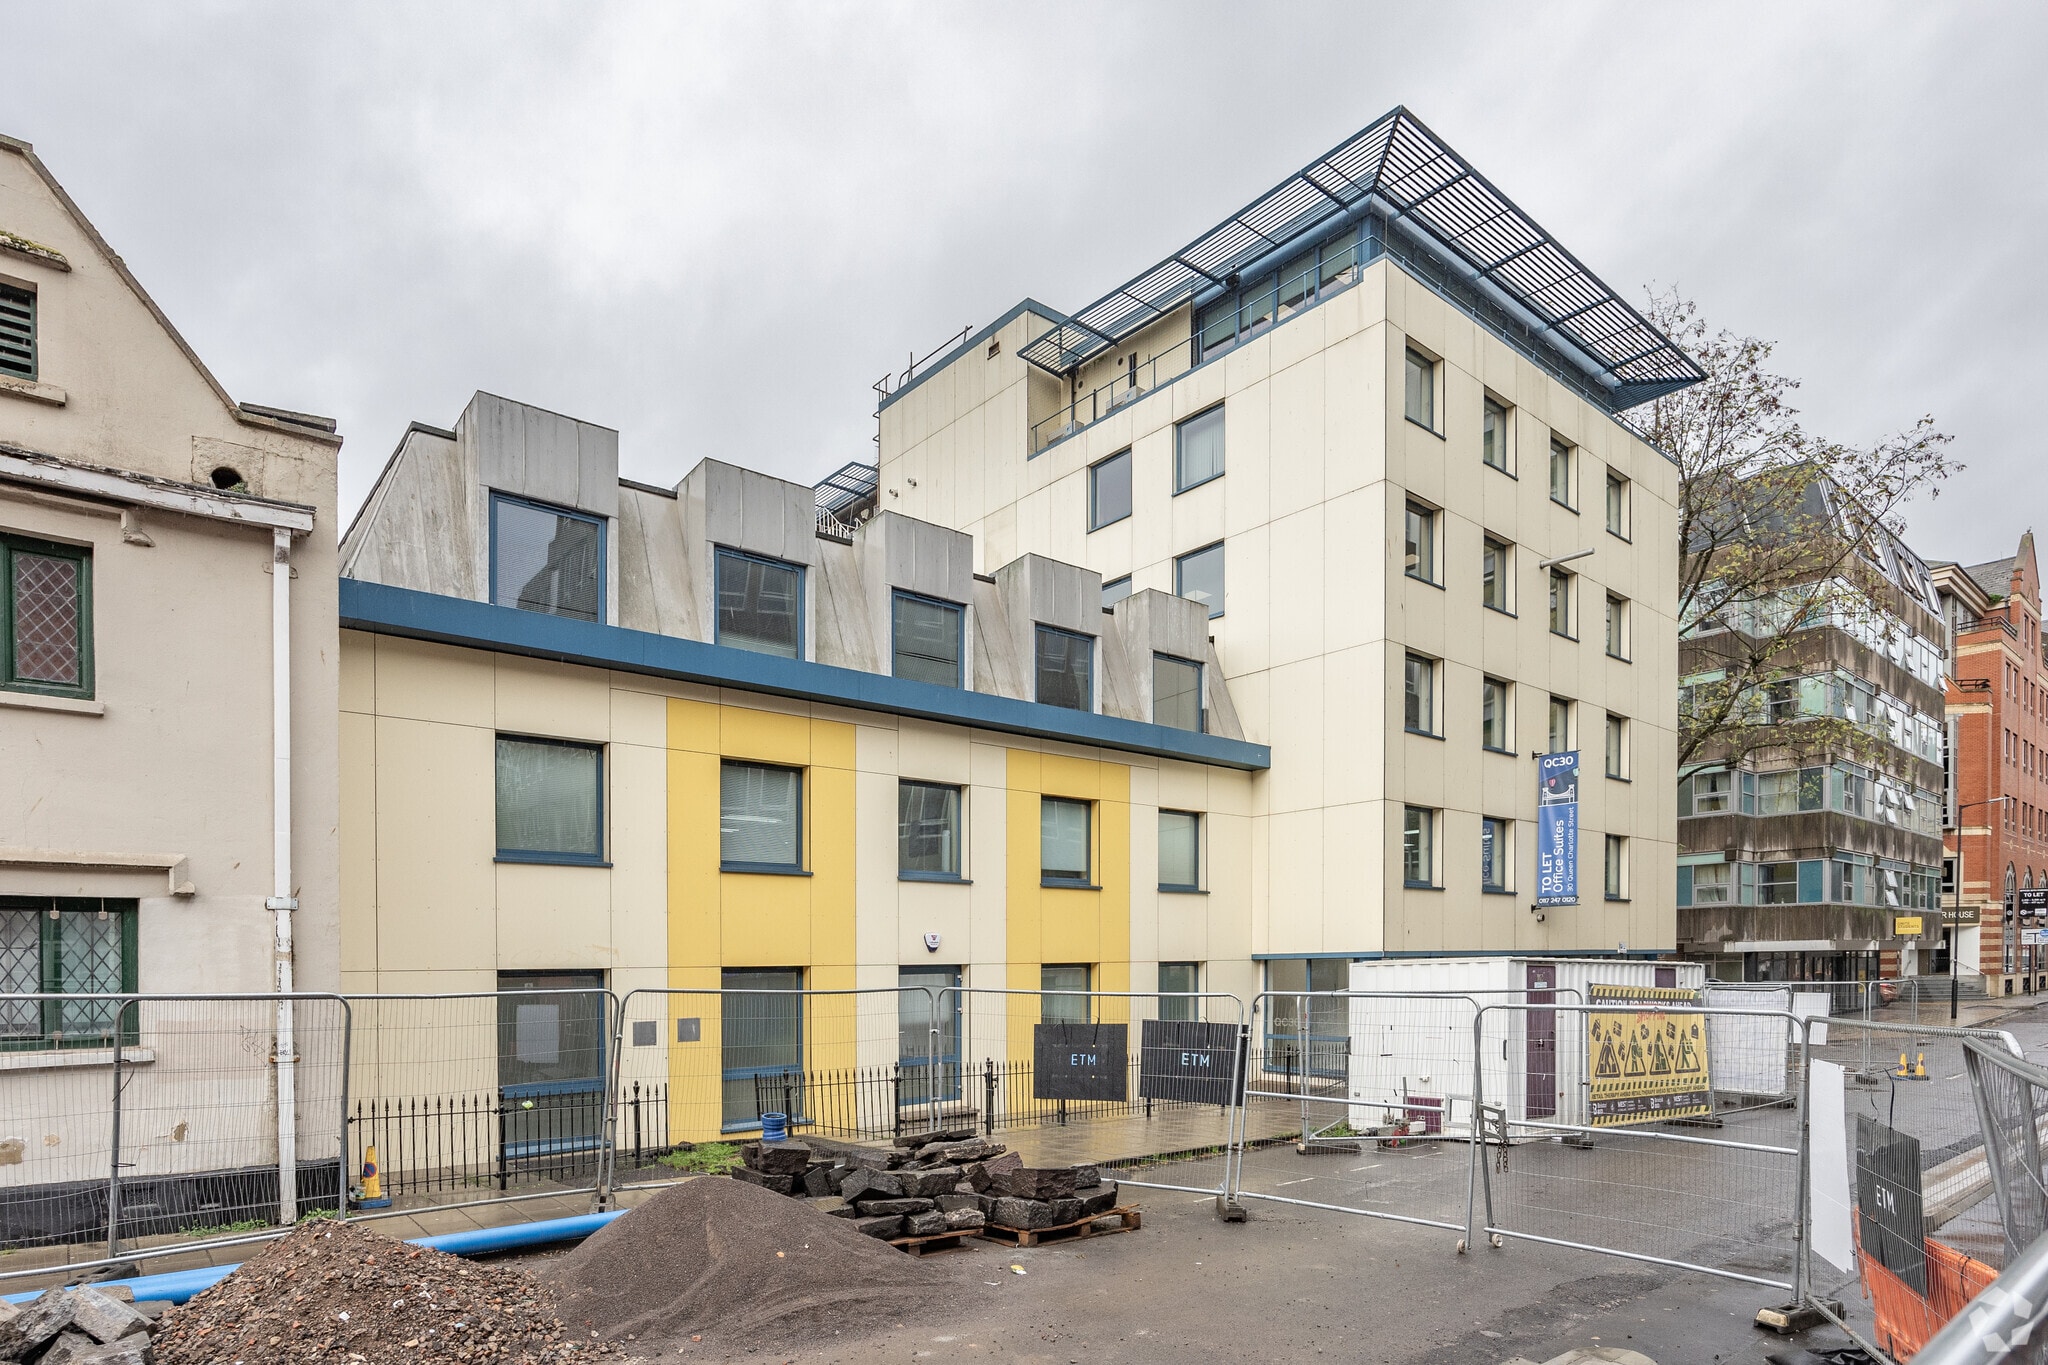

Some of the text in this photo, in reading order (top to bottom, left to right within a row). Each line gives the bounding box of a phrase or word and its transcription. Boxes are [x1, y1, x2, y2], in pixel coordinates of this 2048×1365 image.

[1552, 819, 1565, 893] Office Suites
[1542, 852, 1552, 894] TO LET
[1567, 882, 1574, 892] 30
[1071, 1054, 1096, 1066] ETM
[1181, 1053, 1210, 1067] ETM
[1876, 1184, 1896, 1215] ETM
